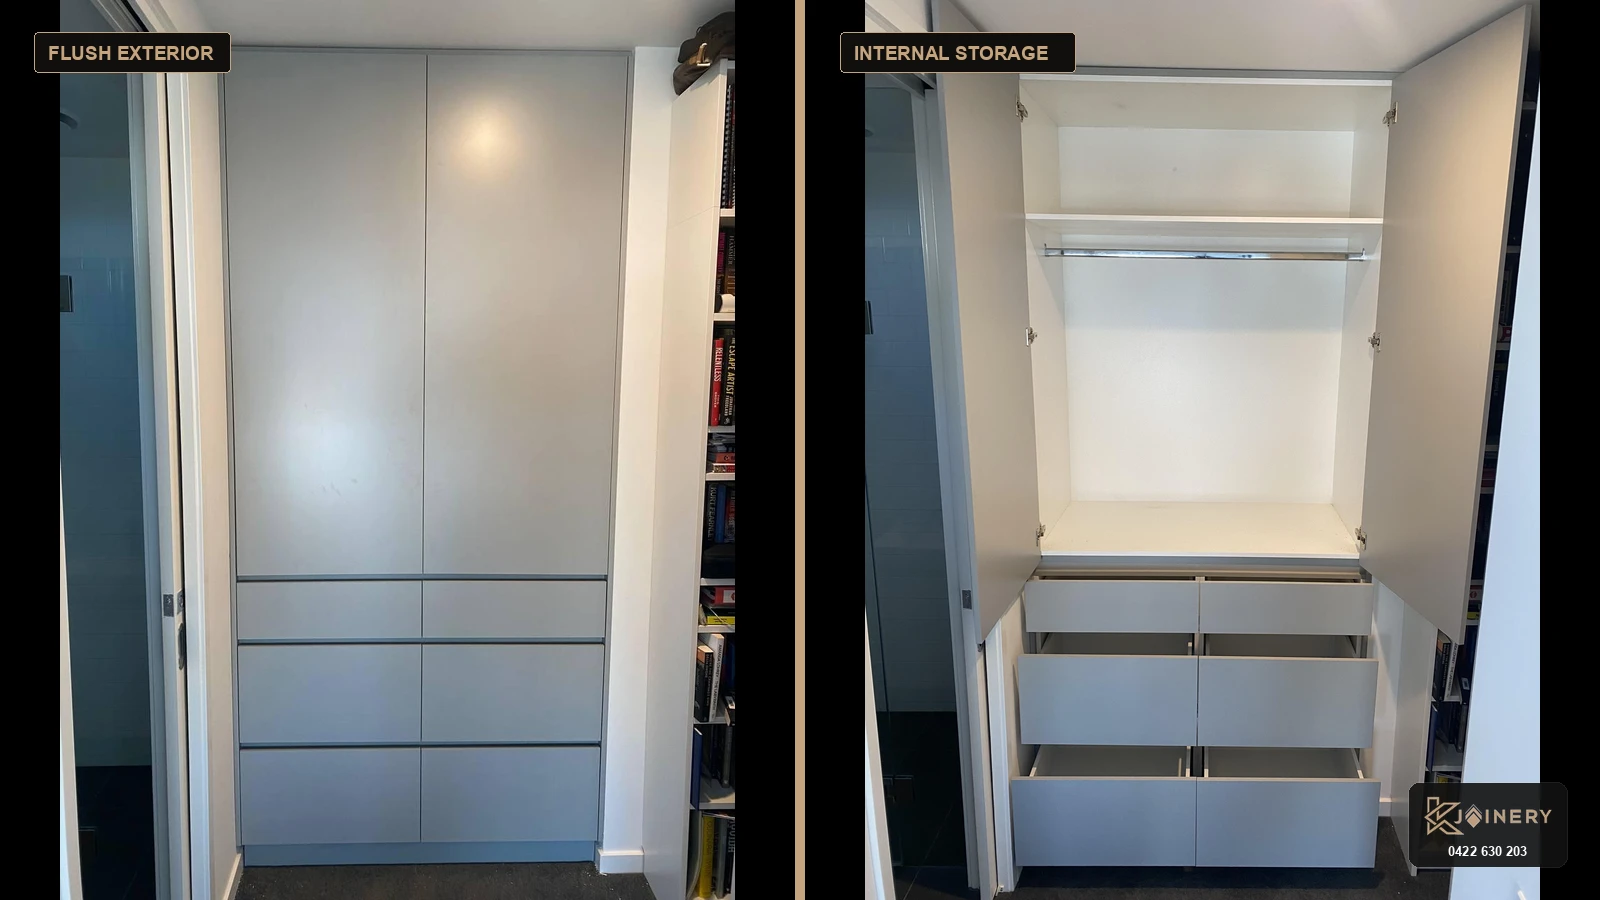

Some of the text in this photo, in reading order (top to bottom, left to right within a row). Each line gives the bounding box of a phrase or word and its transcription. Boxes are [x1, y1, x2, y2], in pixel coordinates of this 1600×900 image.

[714, 347, 723, 382] RELENTLESS
[727, 345, 735, 371] ESCAPE
[725, 372, 735, 395] ARTIST
[709, 487, 717, 505] KURT
